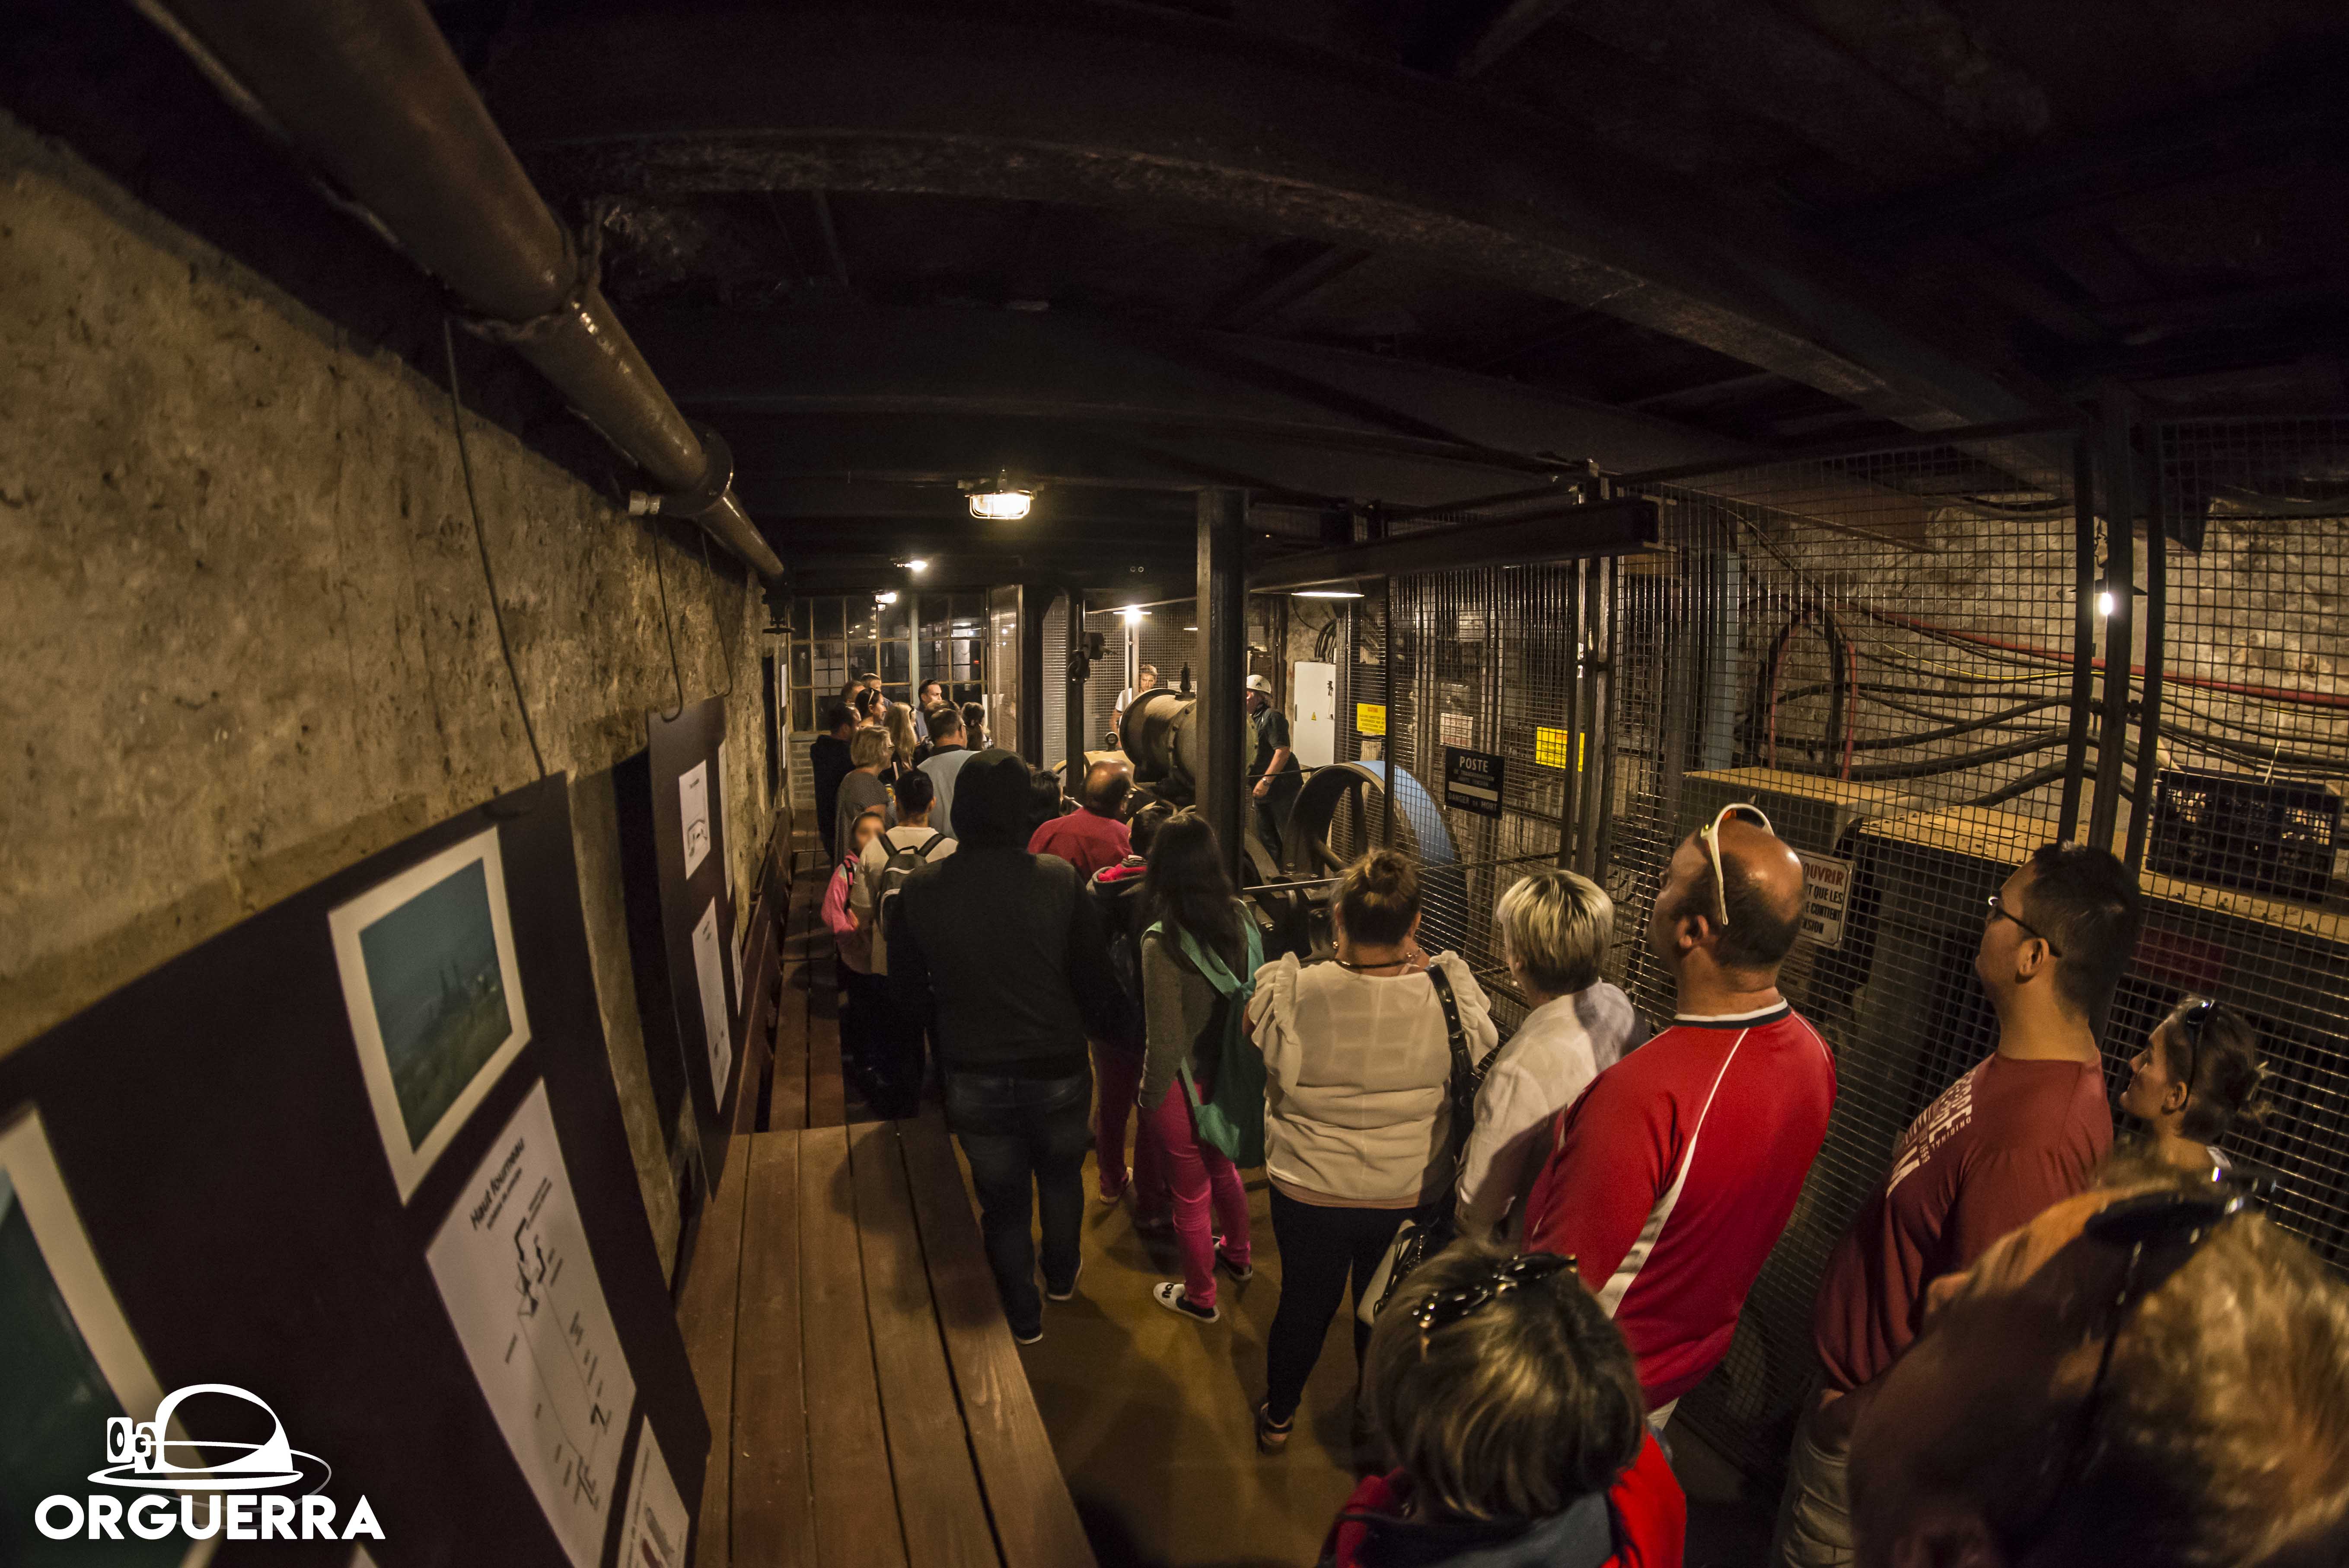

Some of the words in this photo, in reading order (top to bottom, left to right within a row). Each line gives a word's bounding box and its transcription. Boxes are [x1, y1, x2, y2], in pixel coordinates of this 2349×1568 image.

[1460, 756, 1488, 773] POSTE
[1448, 792, 1469, 805] DANGER
[1481, 801, 1497, 811] MORT
[1814, 886, 1829, 900] QUE
[1830, 889, 1843, 903] LES
